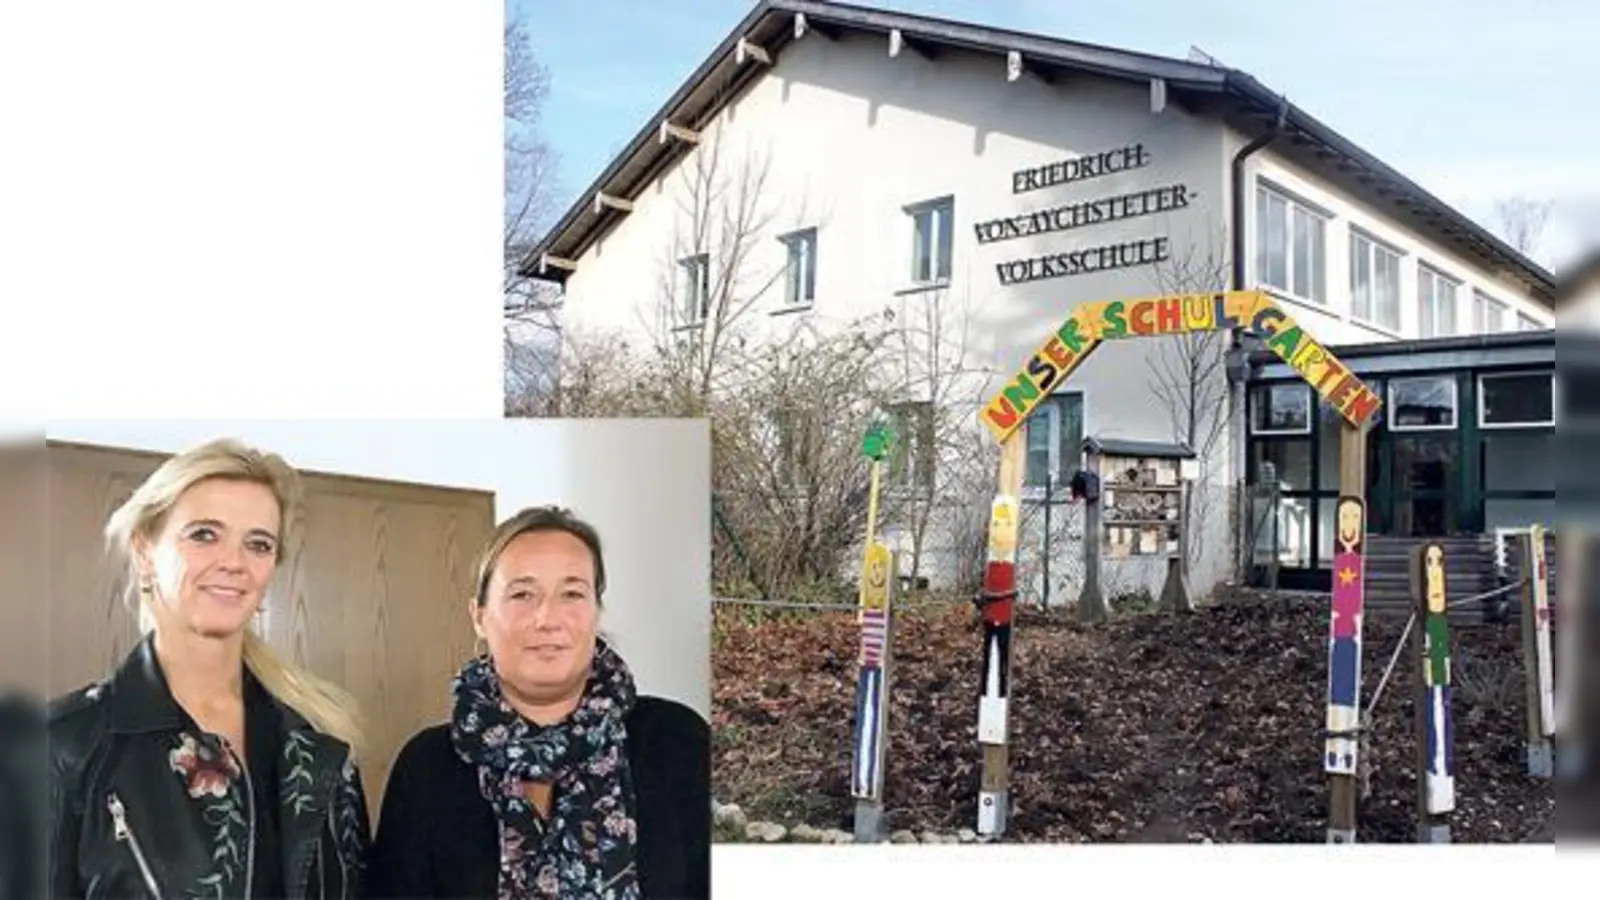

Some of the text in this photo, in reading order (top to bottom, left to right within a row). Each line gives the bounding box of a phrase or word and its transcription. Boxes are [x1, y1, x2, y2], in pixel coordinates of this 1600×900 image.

[1012, 143, 1151, 194] FRIEDRICH-
[996, 237, 1168, 285] VOLKSSCHULE
[988, 317, 1090, 430] UNSER
